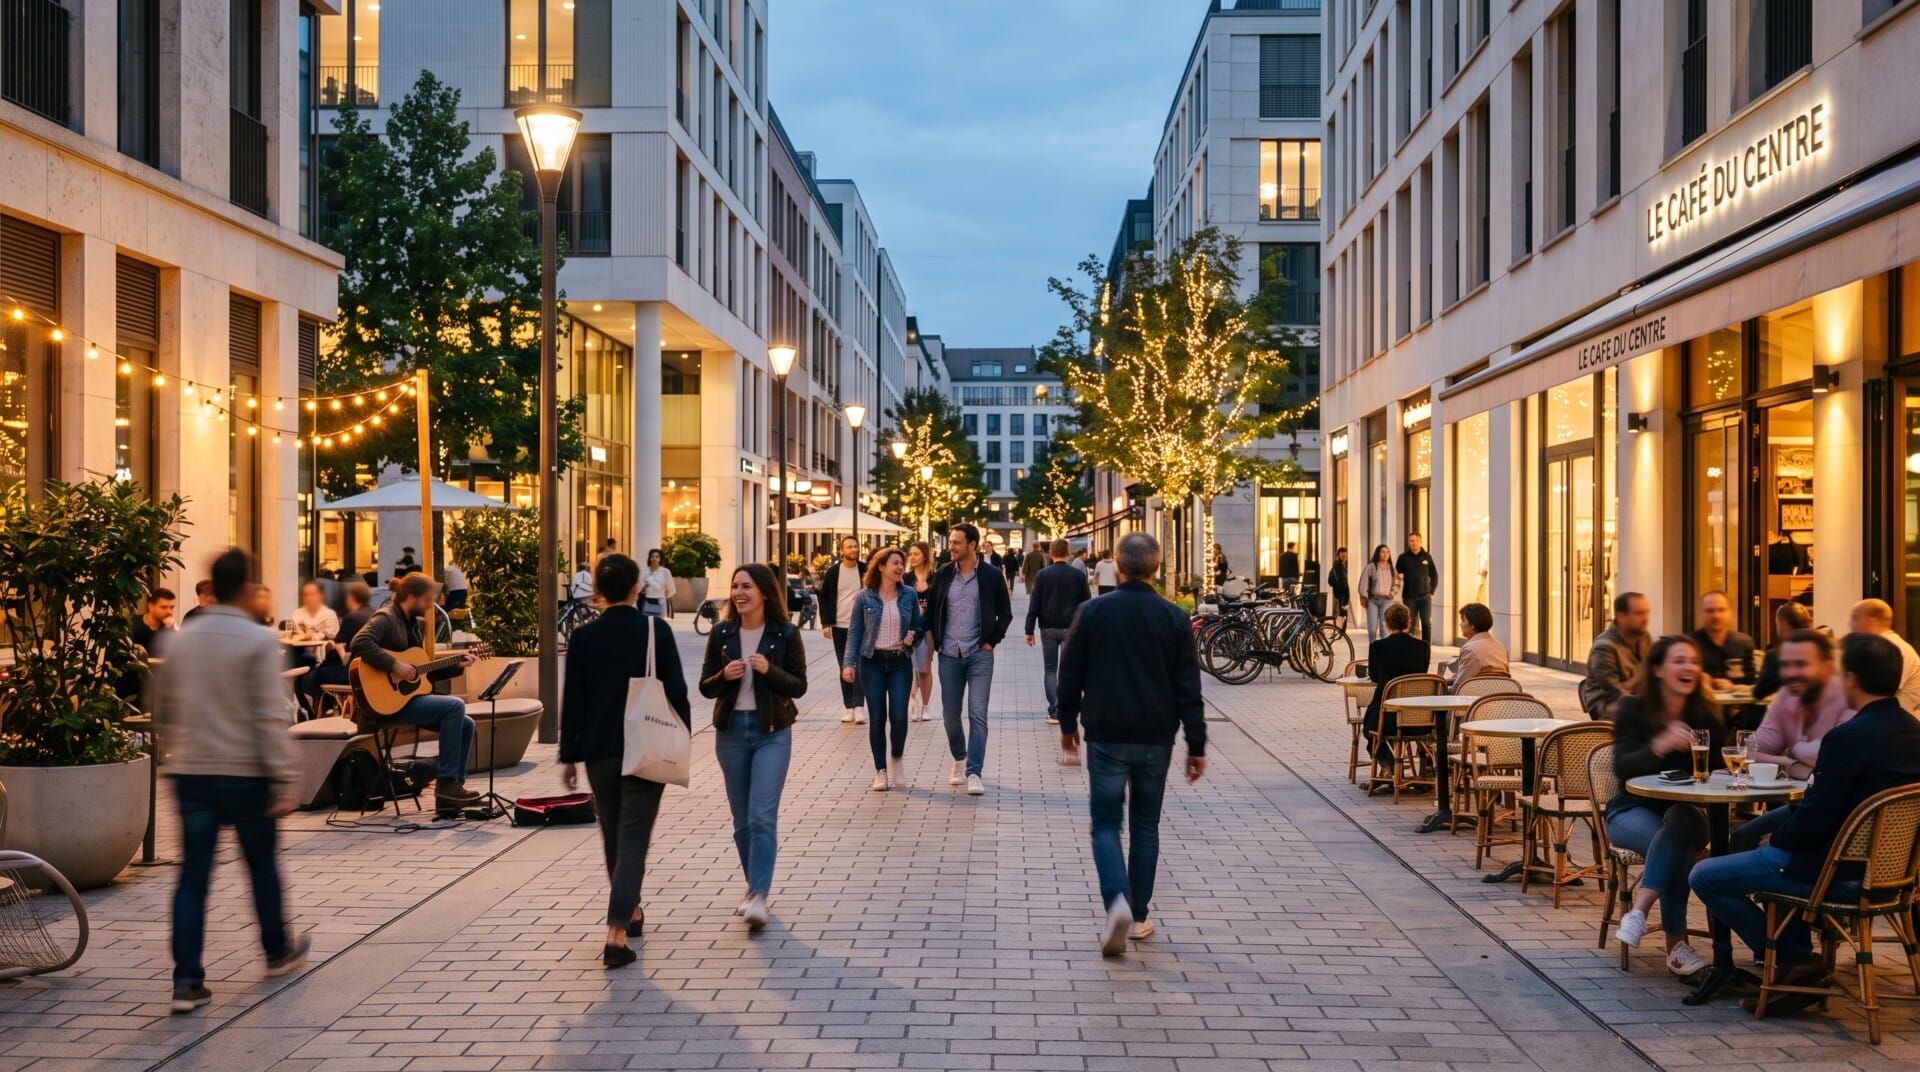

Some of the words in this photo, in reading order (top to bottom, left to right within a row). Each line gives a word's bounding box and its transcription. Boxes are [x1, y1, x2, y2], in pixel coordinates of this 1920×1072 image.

[1647, 201, 1663, 243] LE
[1667, 162, 1708, 231] CAFÉ
[1713, 156, 1739, 207] DU
[1743, 103, 1824, 188] CENTRE
[1578, 347, 1588, 371] LE
[1589, 338, 1611, 366] CAFE
[1613, 332, 1627, 358] DU
[1628, 315, 1666, 352] CENTRE
